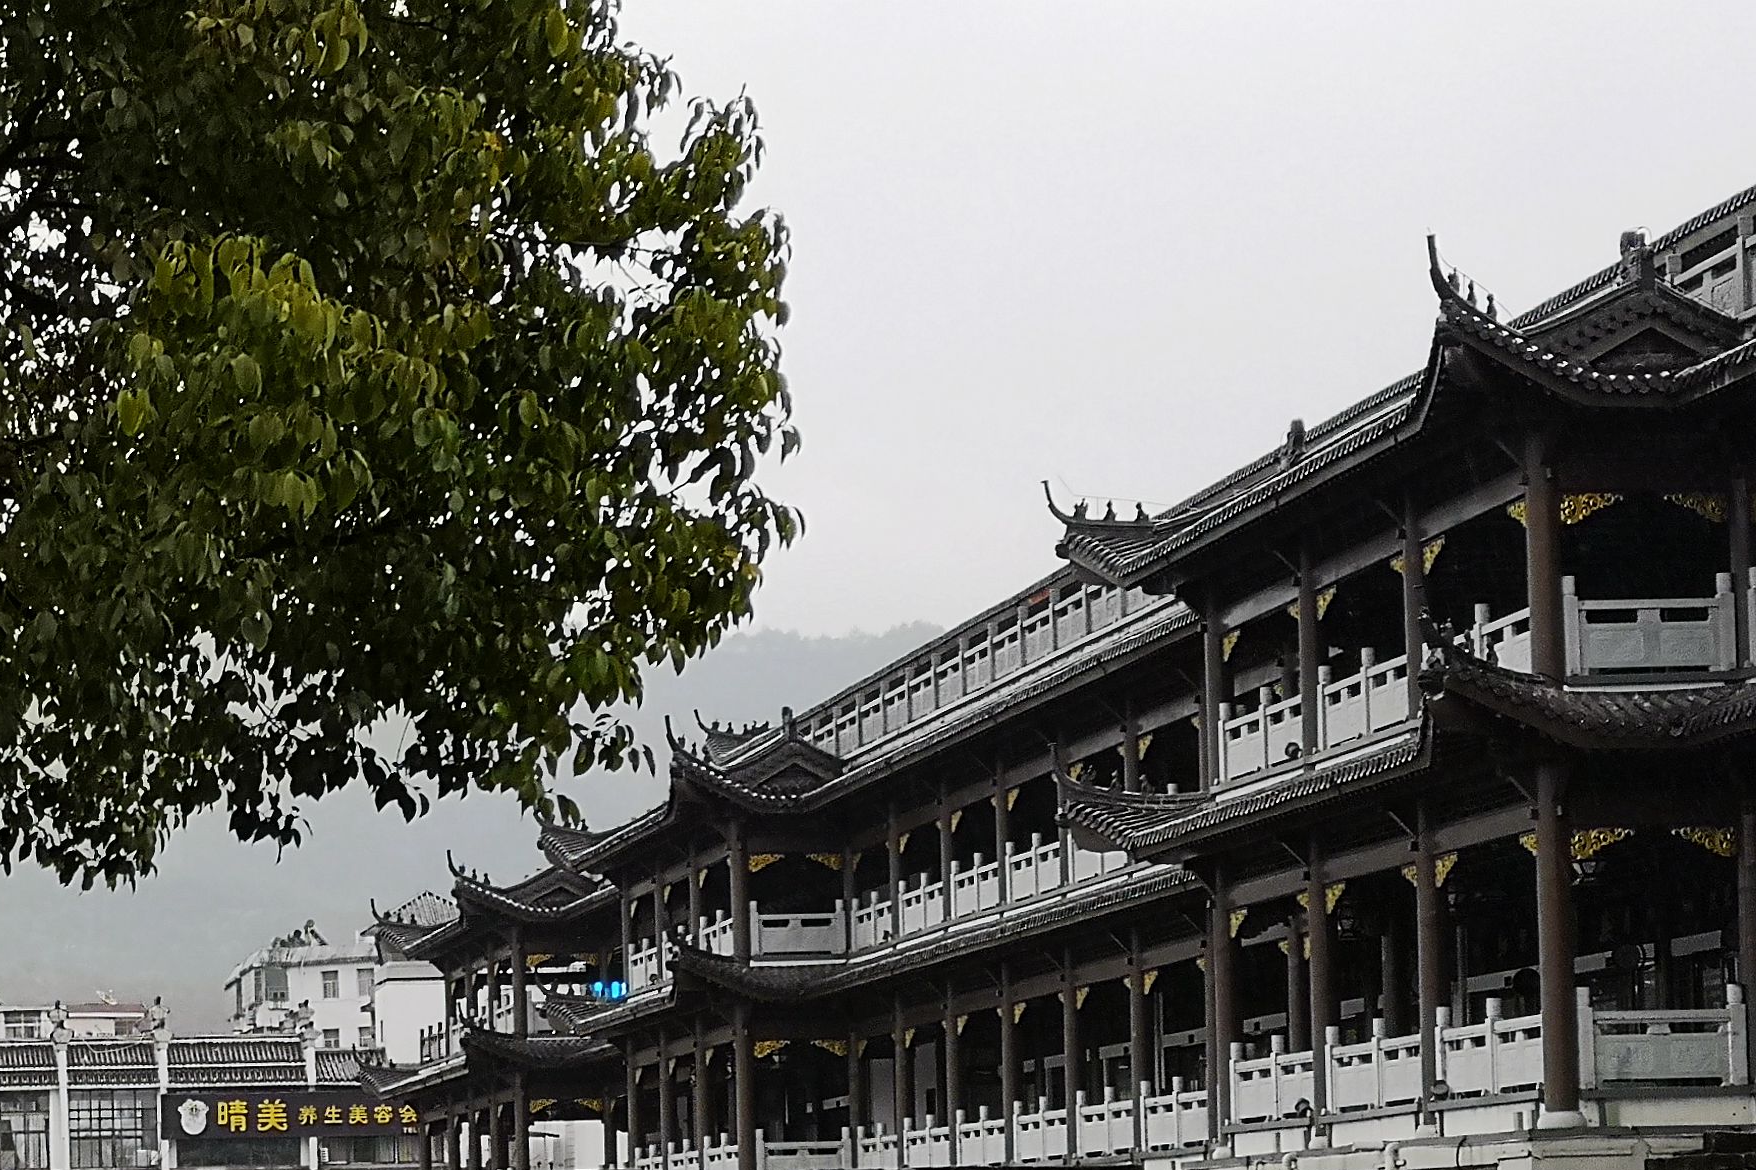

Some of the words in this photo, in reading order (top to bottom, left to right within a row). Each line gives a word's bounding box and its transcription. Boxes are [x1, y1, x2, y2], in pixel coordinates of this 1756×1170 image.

[217, 1099, 288, 1132] 晴美
[298, 1104, 418, 1125] 养生美容会
